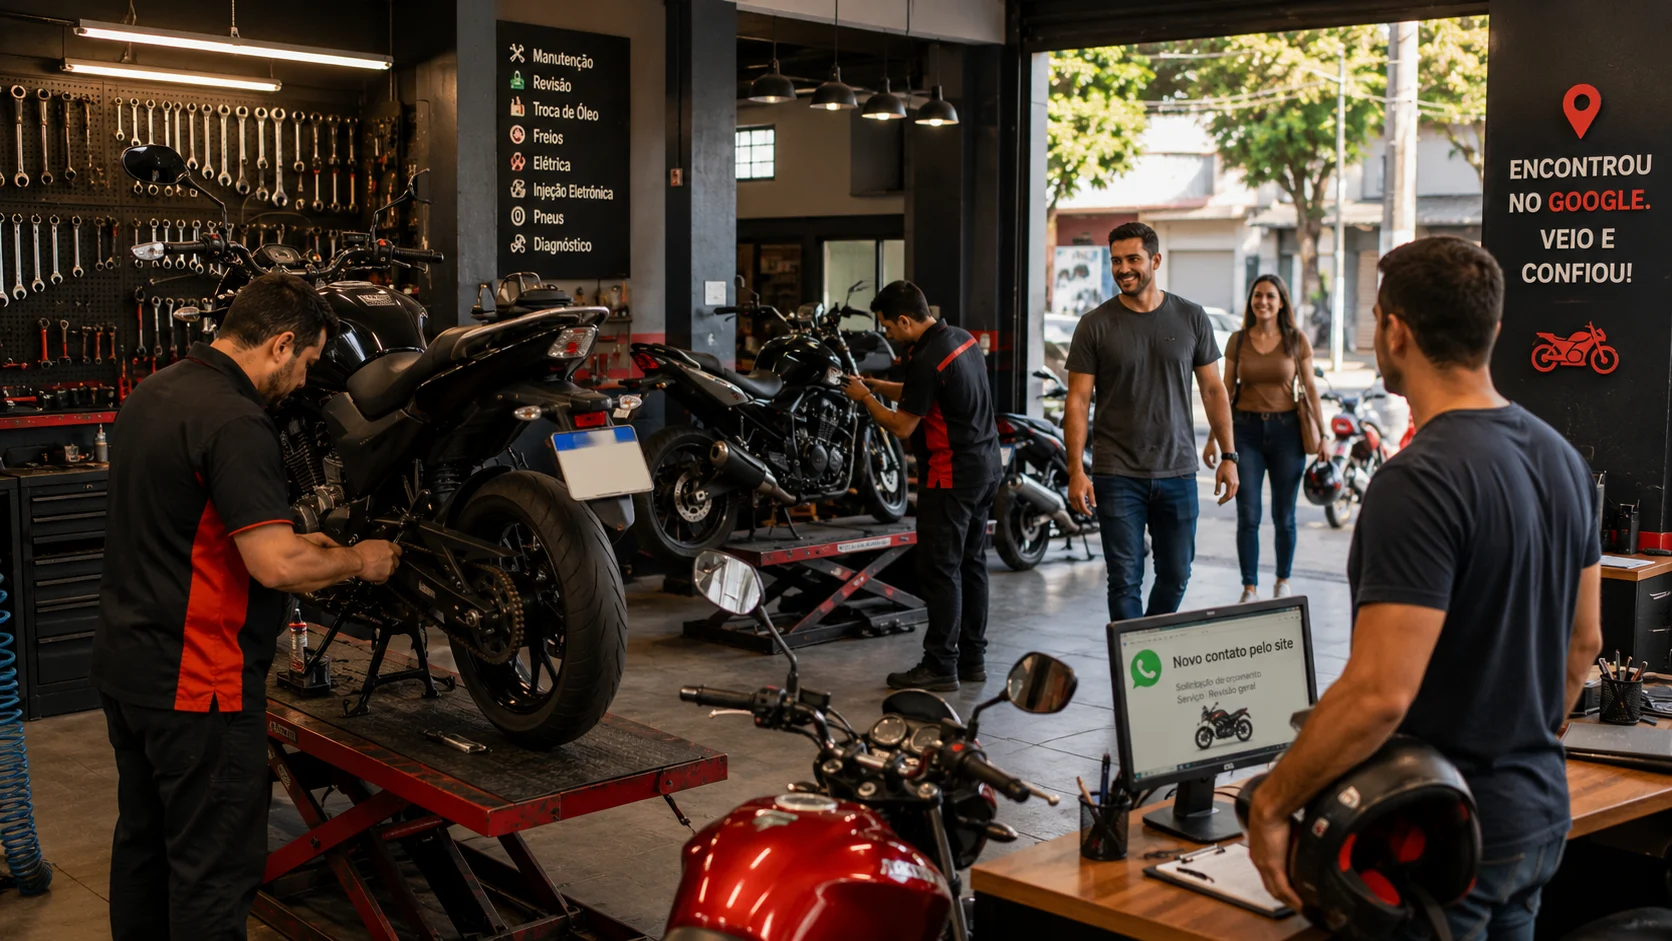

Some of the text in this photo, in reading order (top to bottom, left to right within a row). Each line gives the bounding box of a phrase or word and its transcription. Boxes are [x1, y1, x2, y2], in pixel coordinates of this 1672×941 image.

[533, 48, 593, 71] Manutenção
[533, 75, 572, 92] Revisão
[533, 101, 599, 121] Troca de Óleo
[533, 128, 564, 145] Freios
[533, 155, 571, 172] Elétrica
[1509, 154, 1652, 180] ENCONTROU
[533, 182, 567, 201] Injeção
[1508, 189, 1651, 213] NO GOOGLE.
[534, 209, 565, 225] Pneus
[534, 236, 592, 255] Diagnóstico
[1540, 228, 1616, 249] VEIO E
[1521, 263, 1633, 283] CONFIOU!
[1172, 638, 1294, 669] Novo contato pelo site
[1238, 681, 1256, 695] geral
